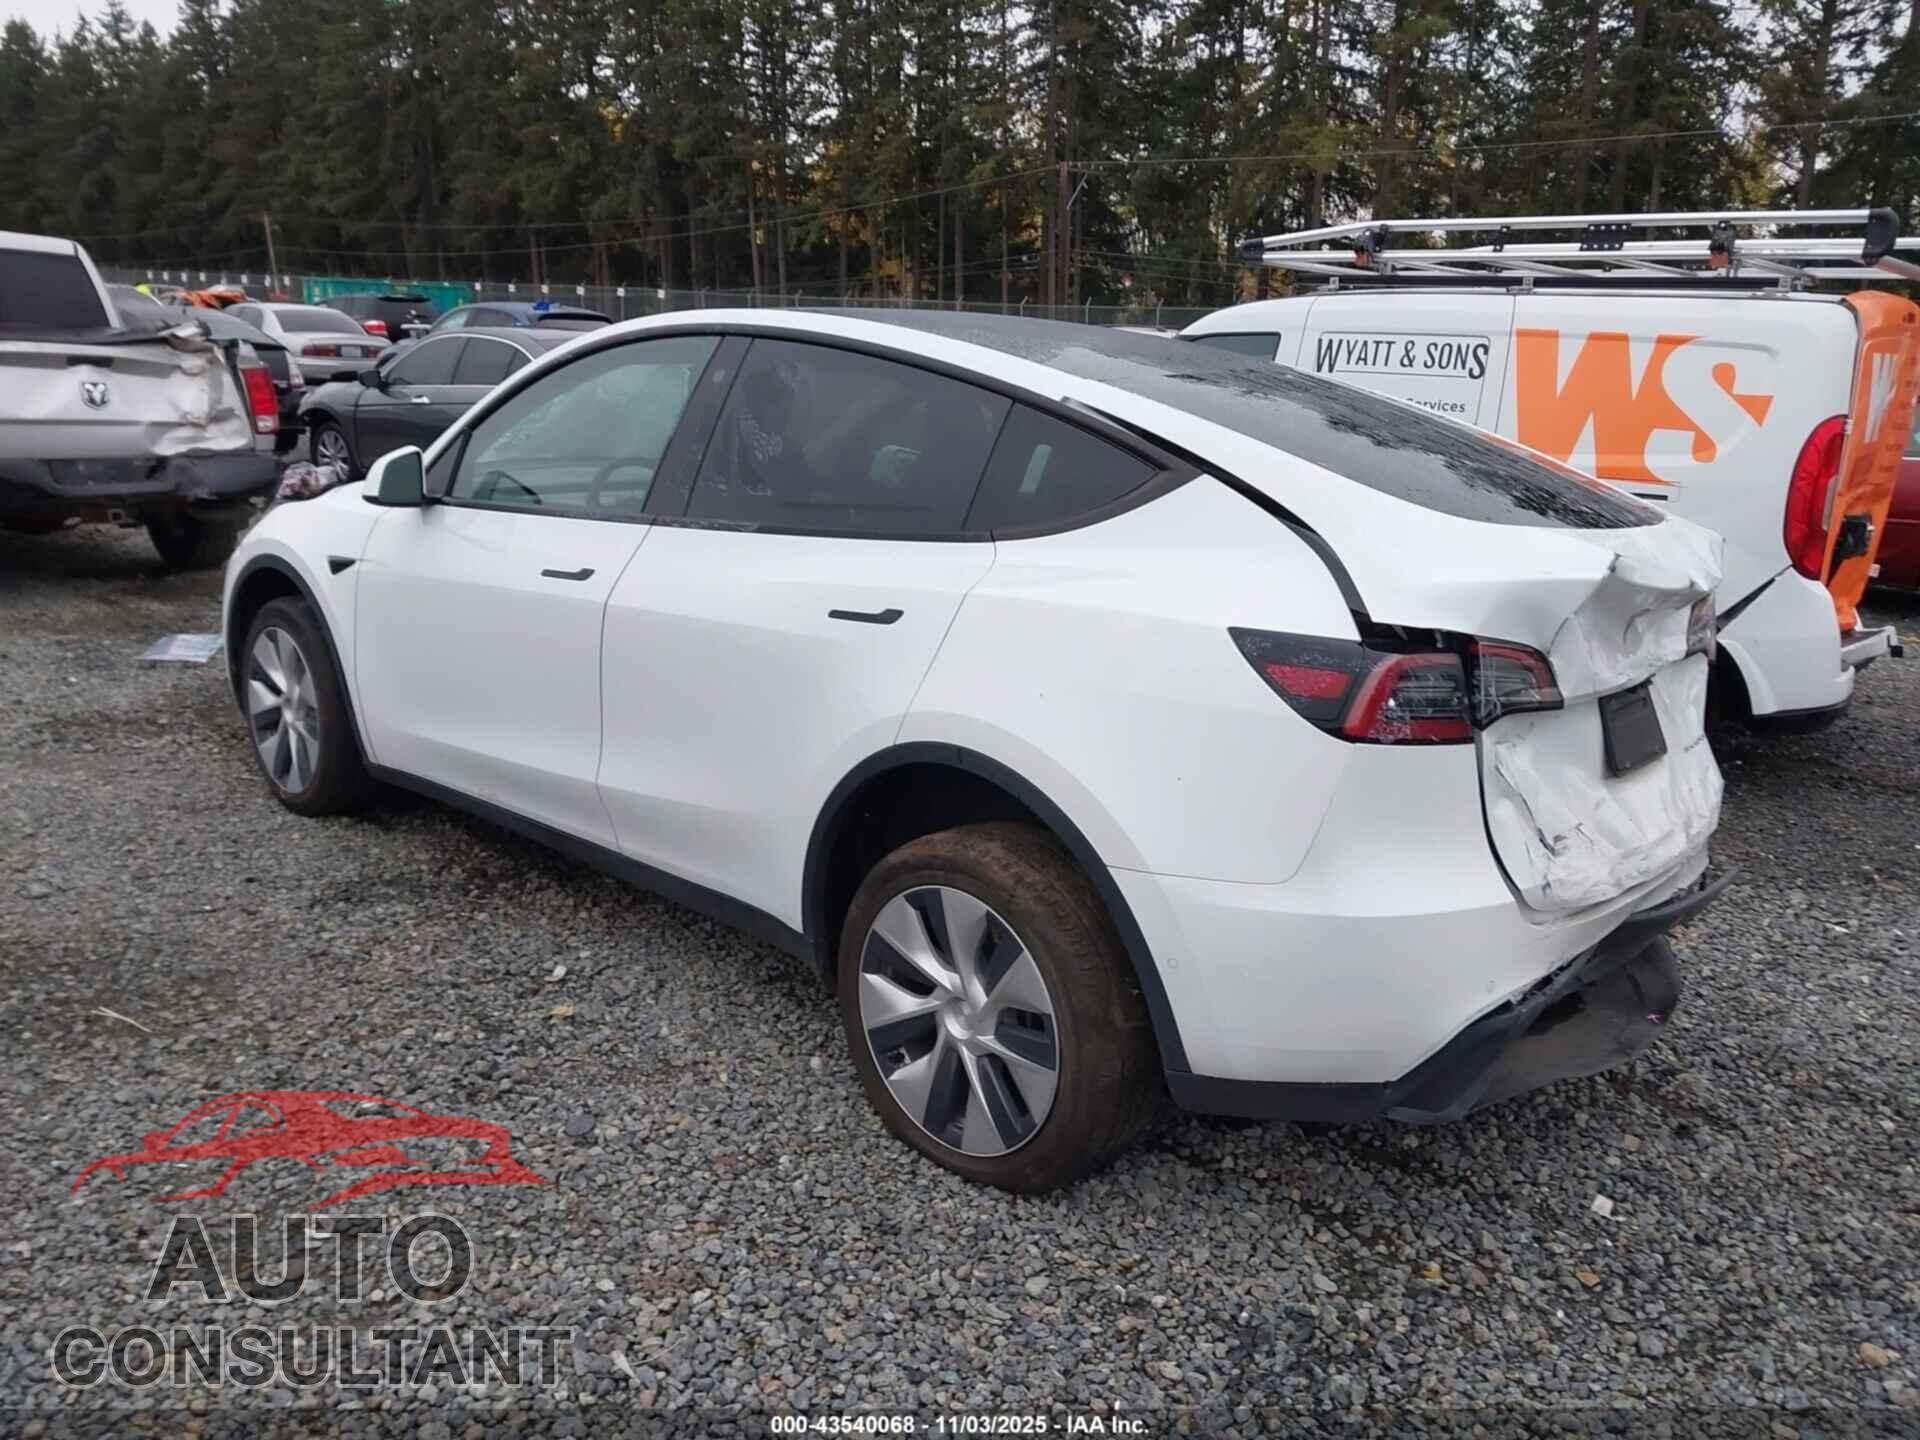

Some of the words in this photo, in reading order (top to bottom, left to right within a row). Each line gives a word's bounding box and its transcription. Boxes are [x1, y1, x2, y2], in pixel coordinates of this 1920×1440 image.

[1316, 338, 1397, 374] WYATT
[1400, 340, 1417, 368] &
[1423, 342, 1490, 380] SONS
[1405, 397, 1466, 413] rvices
[1515, 328, 1775, 486] WS
